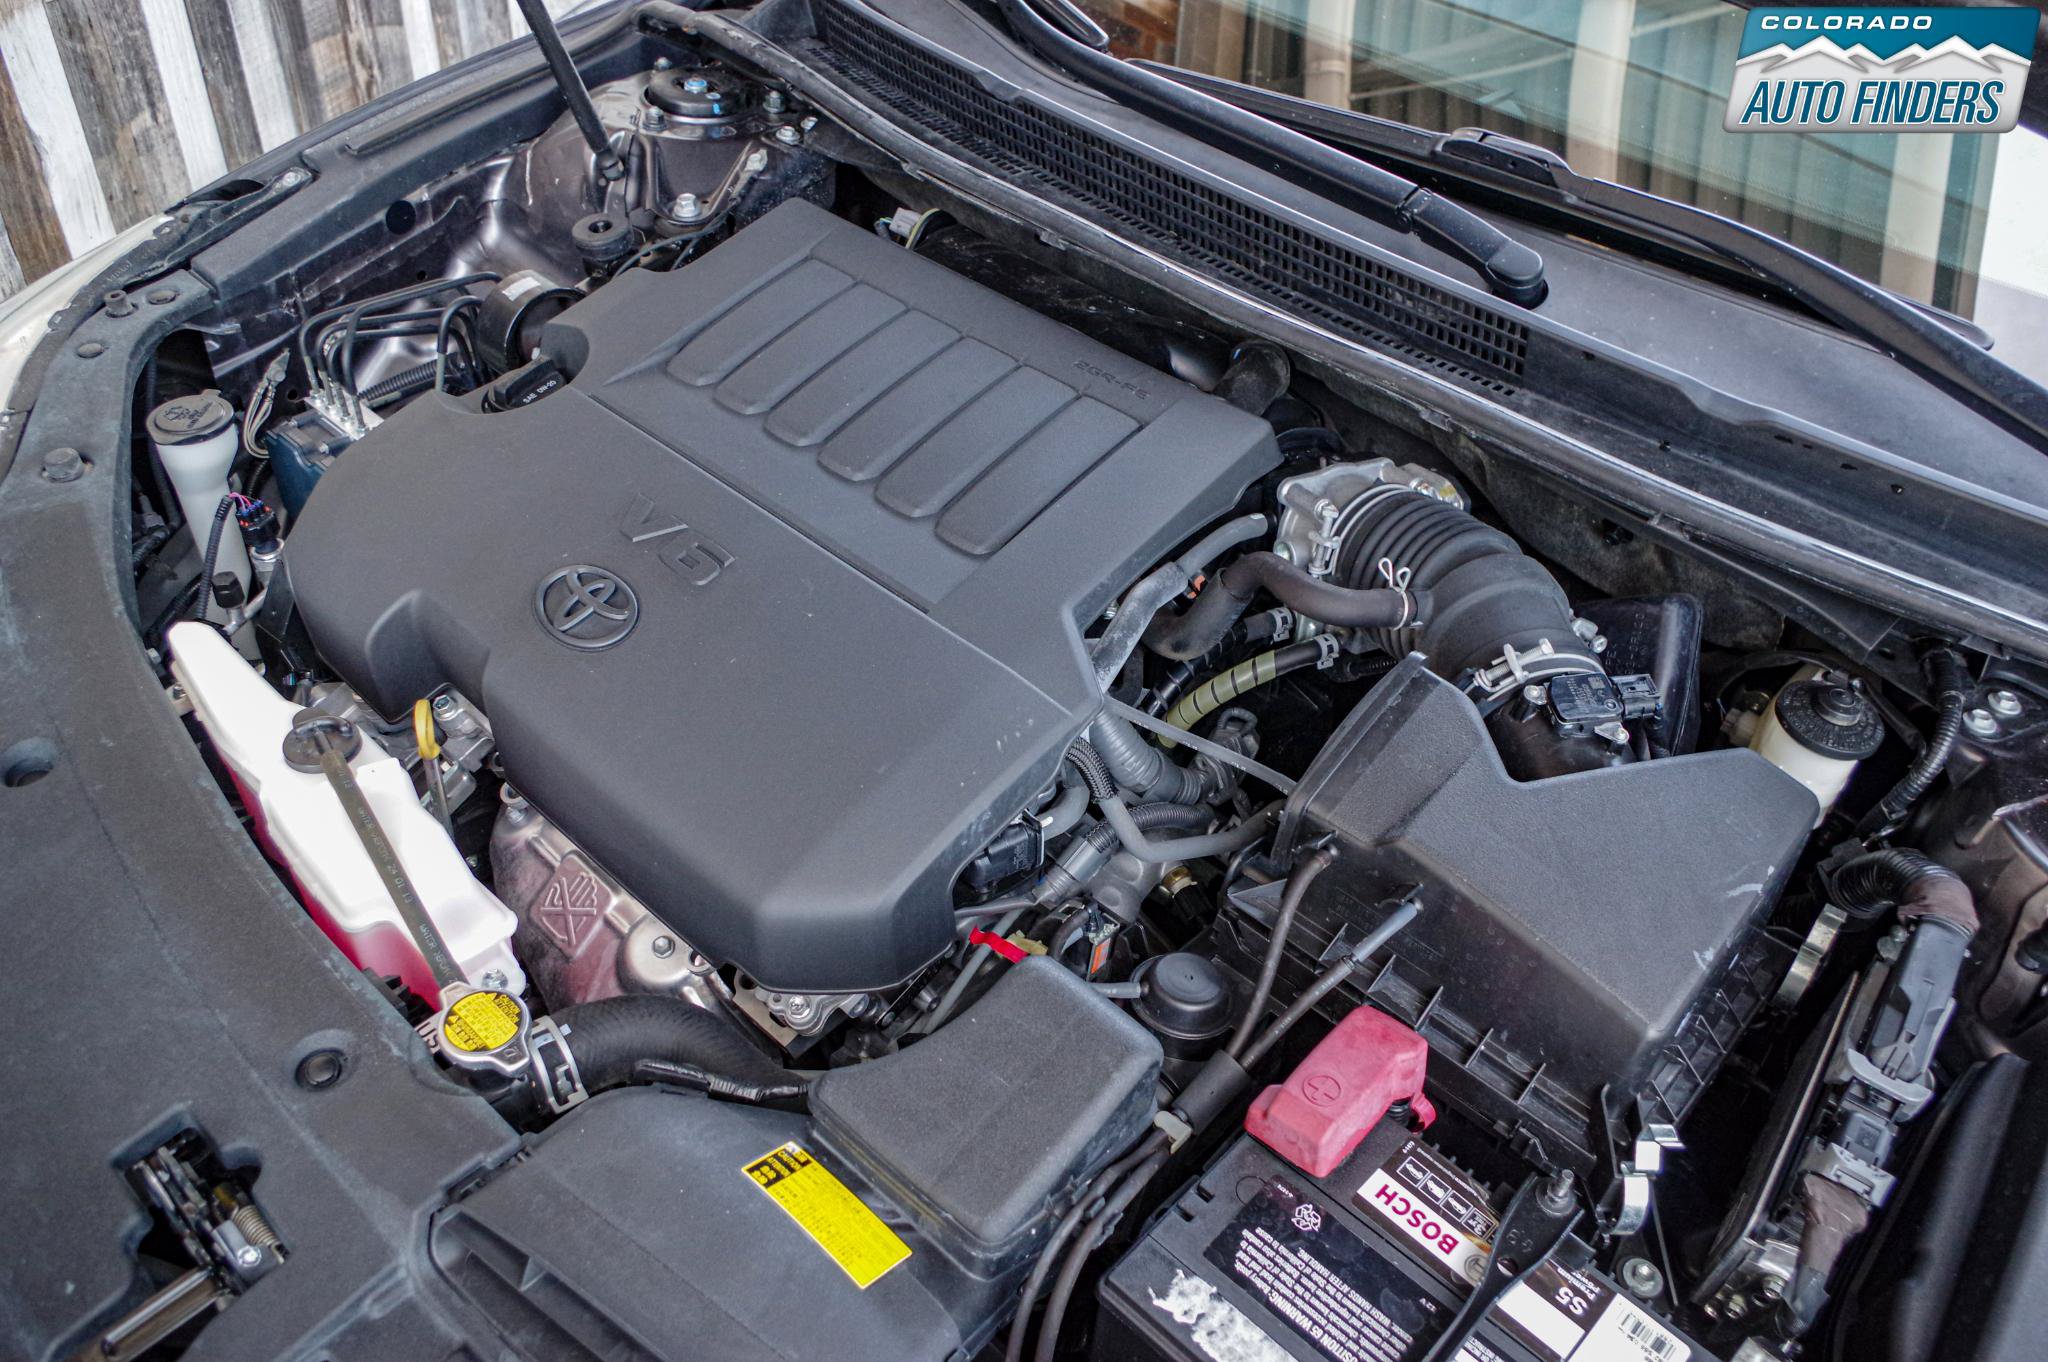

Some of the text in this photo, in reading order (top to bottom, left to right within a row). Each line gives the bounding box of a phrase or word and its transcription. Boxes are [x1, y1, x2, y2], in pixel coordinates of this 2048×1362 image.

[1073, 360, 1152, 400] 2GR-FE
[523, 392, 538, 404] SAE
[620, 492, 736, 586] V6
[1374, 1183, 1459, 1255] BOSCH
[1238, 1239, 1249, 1249] to
[1240, 1227, 1264, 1249] contain
[1235, 1249, 1252, 1265] lead
[1244, 1244, 1274, 1271] California
[1260, 1244, 1276, 1259] also
[1294, 1246, 1331, 1278] HANDLING.
[1247, 1259, 1262, 1273] and
[1258, 1268, 1275, 1284] lead
[1270, 1265, 1280, 1276] of
[1272, 1253, 1300, 1279] Batteries
[1247, 1271, 1272, 1295] Battery
[1254, 1225, 1407, 1352] other chemicals known to the State of California to cause
[1276, 1270, 1295, 1287] State
[1292, 1283, 1305, 1295] the
[1327, 1273, 1350, 1294] AFTER
[1557, 1267, 1597, 1301] Premium
[1271, 1278, 1295, 1301] contain
[1301, 1290, 1311, 1300] to
[1346, 1288, 1372, 1311] HANDS
[1265, 1288, 1314, 1331] WARNING:
[1291, 1295, 1328, 1327] accessories
[1308, 1295, 1330, 1315] known
[1313, 1286, 1352, 1320] reproductive
[1555, 1286, 1588, 1316] S5
[1326, 1310, 1359, 1339] chemicals
[1348, 1315, 1363, 1329] and
[1368, 1306, 1391, 1327] WASH
[1308, 1324, 1324, 1340] 65
[1324, 1322, 1348, 1344] related
[1360, 1324, 1382, 1344] cancer
[1344, 1339, 1359, 1353] and
[1380, 1341, 1400, 1359] cause
